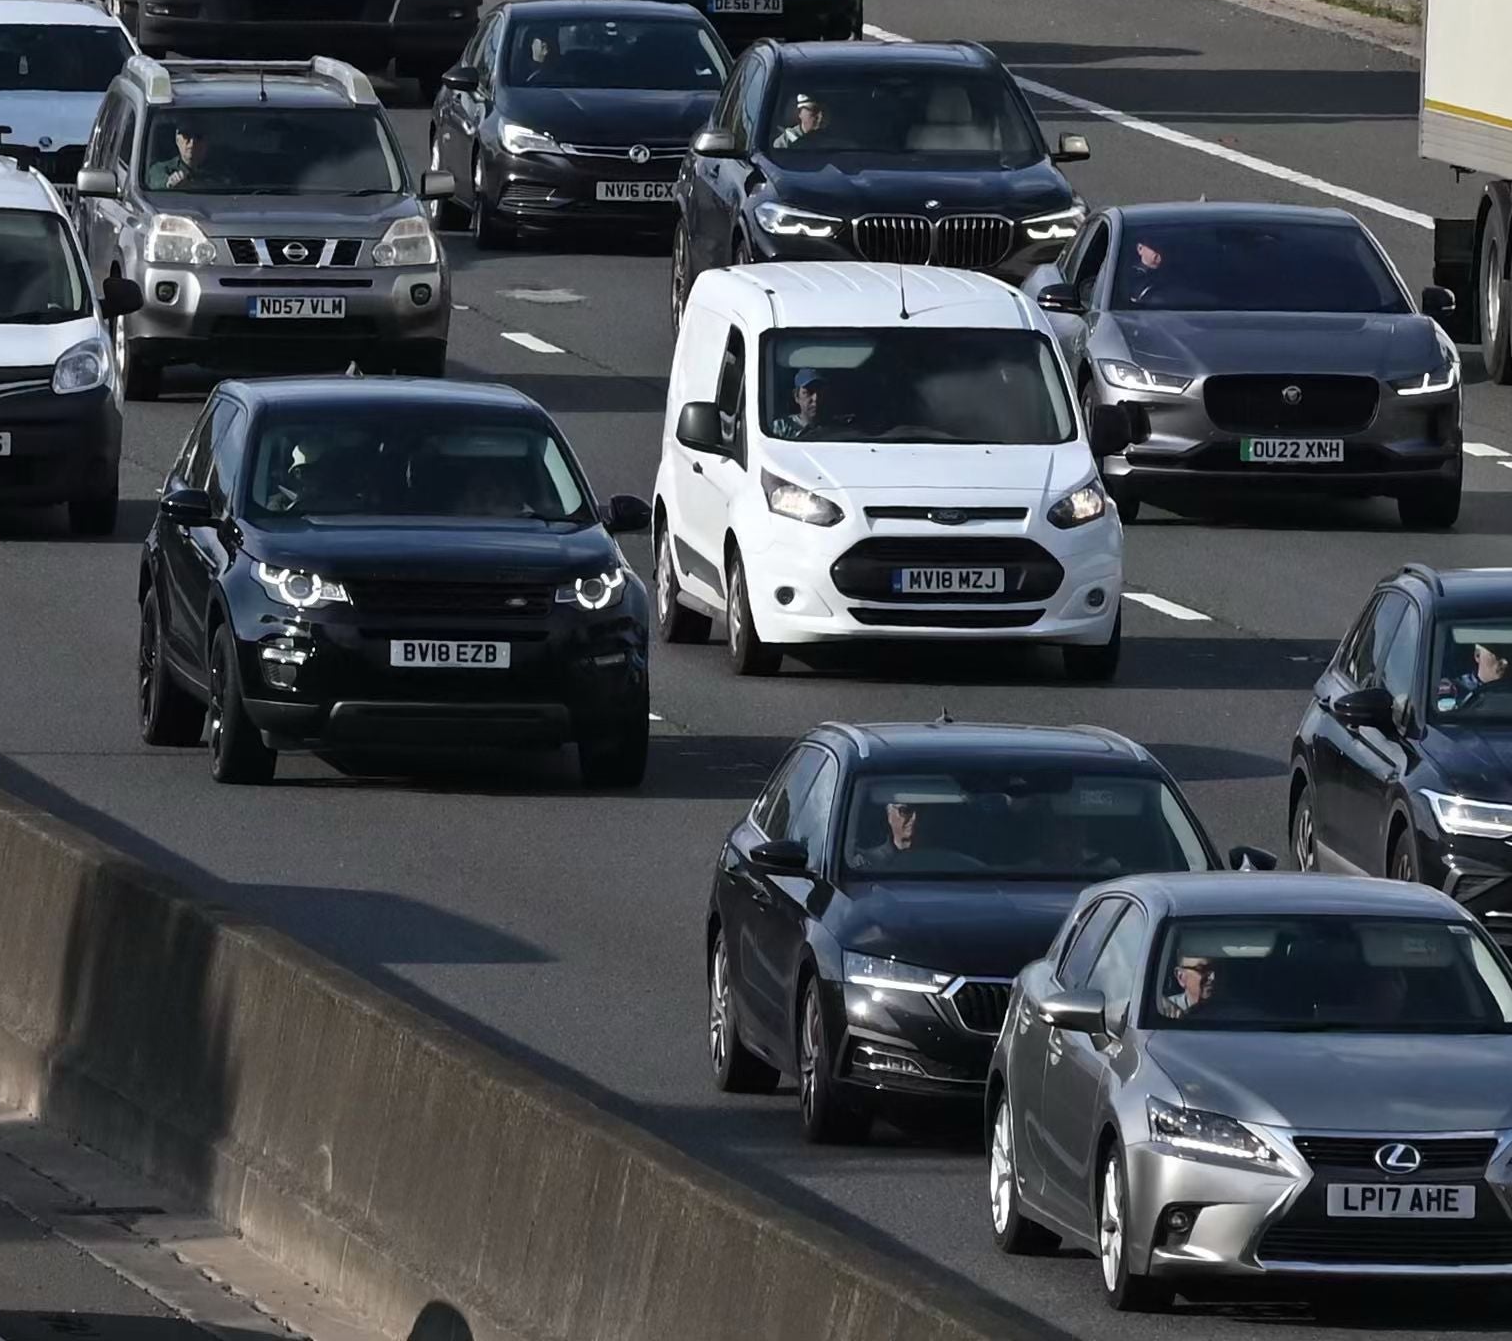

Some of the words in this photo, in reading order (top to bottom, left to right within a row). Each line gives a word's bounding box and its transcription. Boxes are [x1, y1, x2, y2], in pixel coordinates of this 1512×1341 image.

[604, 183, 639, 198] NV16
[259, 297, 305, 315] ND57
[309, 297, 344, 316] VLM
[1306, 439, 1342, 459] XNH
[908, 569, 953, 590] MV18
[960, 569, 997, 590] MZJ
[403, 642, 450, 664] BV18
[460, 642, 497, 665] EZB
[1342, 1187, 1401, 1213] LP17
[1407, 1187, 1460, 1214] AHE
